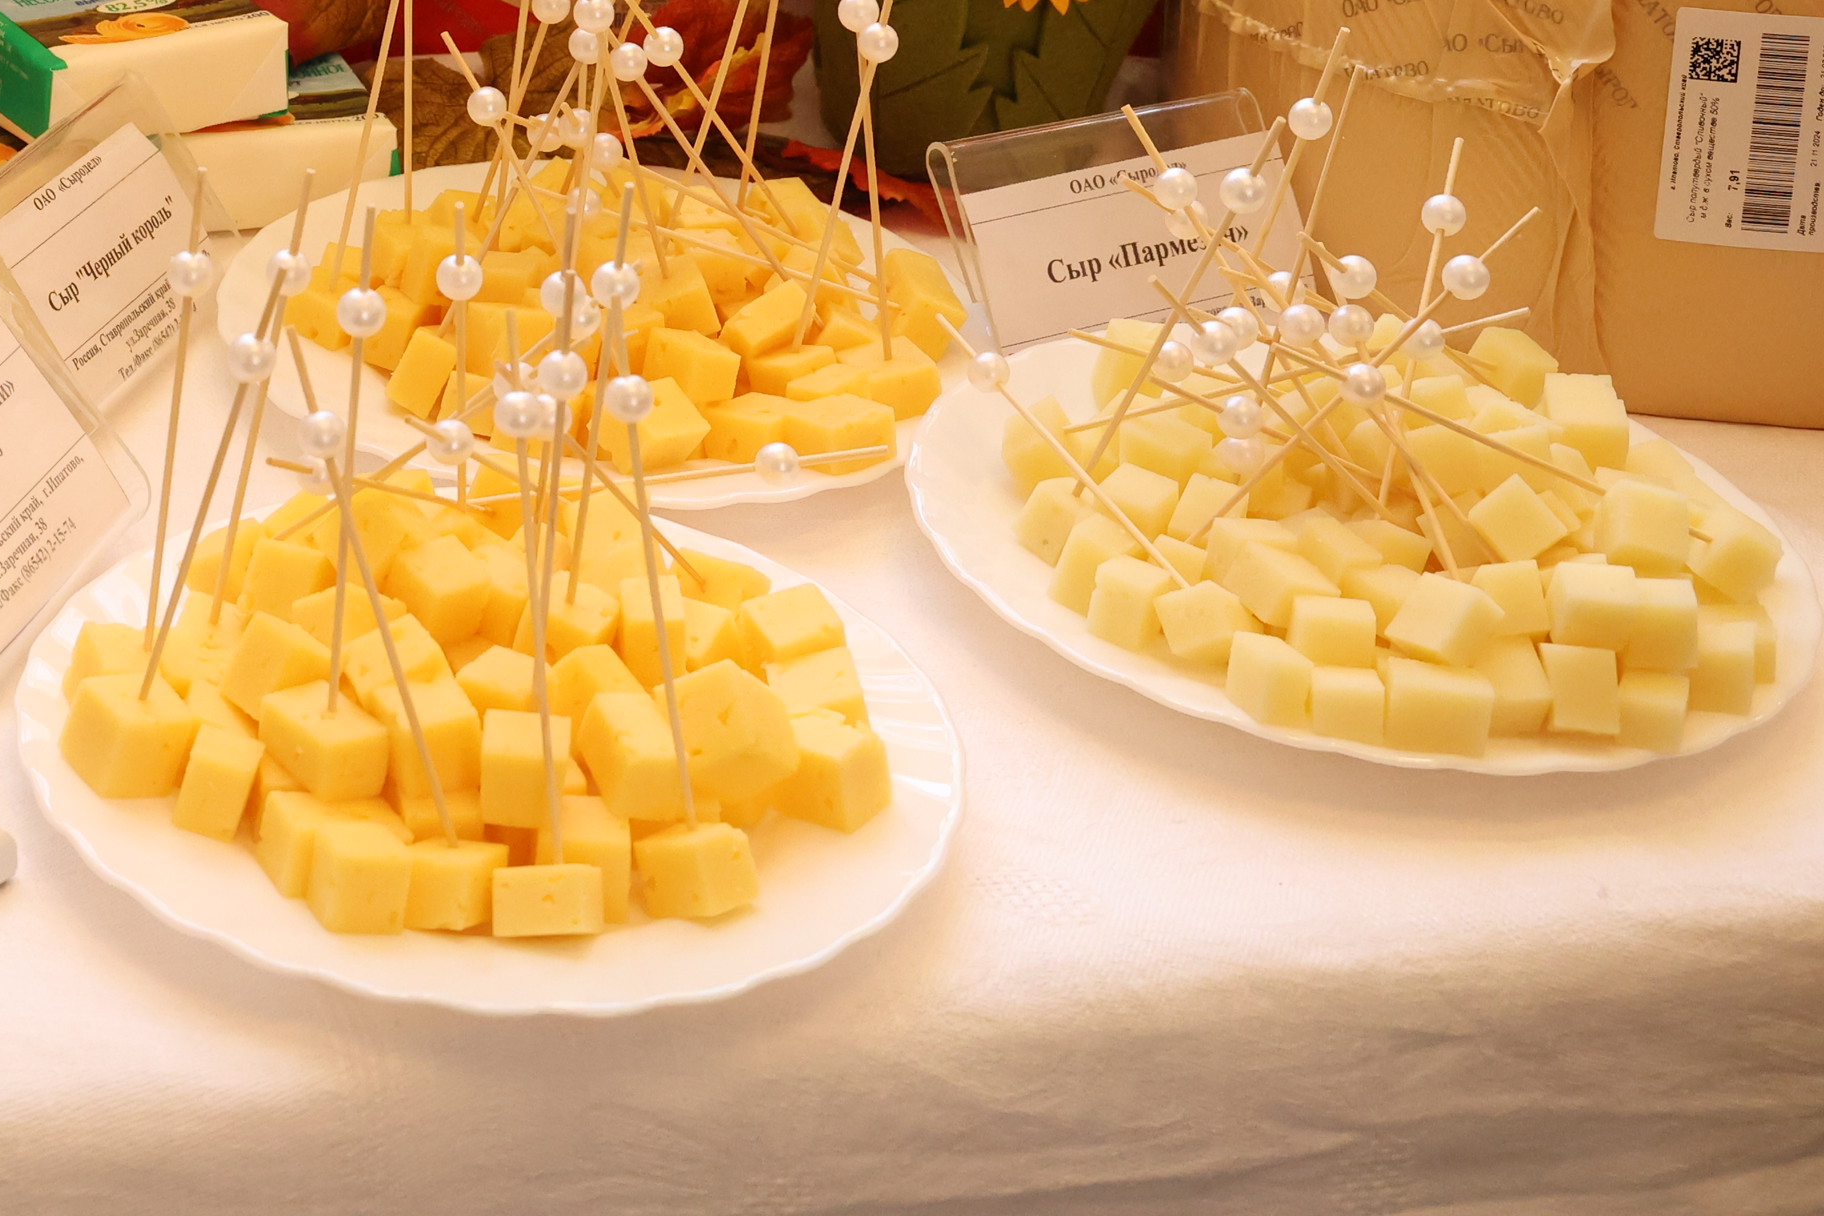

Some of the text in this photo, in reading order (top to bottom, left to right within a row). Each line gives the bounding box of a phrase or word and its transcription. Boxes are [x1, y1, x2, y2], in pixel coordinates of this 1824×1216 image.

[1709, 97, 1720, 115] 50%
[33, 156, 103, 211] ОАО «Сыродел»
[1070, 175, 1105, 194] ОАО
[1688, 148, 1703, 204] полутвердый
[1728, 169, 1741, 191] 7,91
[1686, 205, 1698, 223] Сыр
[1797, 215, 1807, 236] Дата
[48, 195, 174, 312] Сыр "Черный король"
[1047, 256, 1102, 285] Сыр
[72, 291, 156, 371] Россия, Ставропольский
[20, 495, 45, 523] край,
[42, 455, 85, 499] г.Ипатово,
[37, 517, 48, 535] 38
[20, 546, 53, 584] (86542)
[46, 516, 77, 553] 2-15-74
